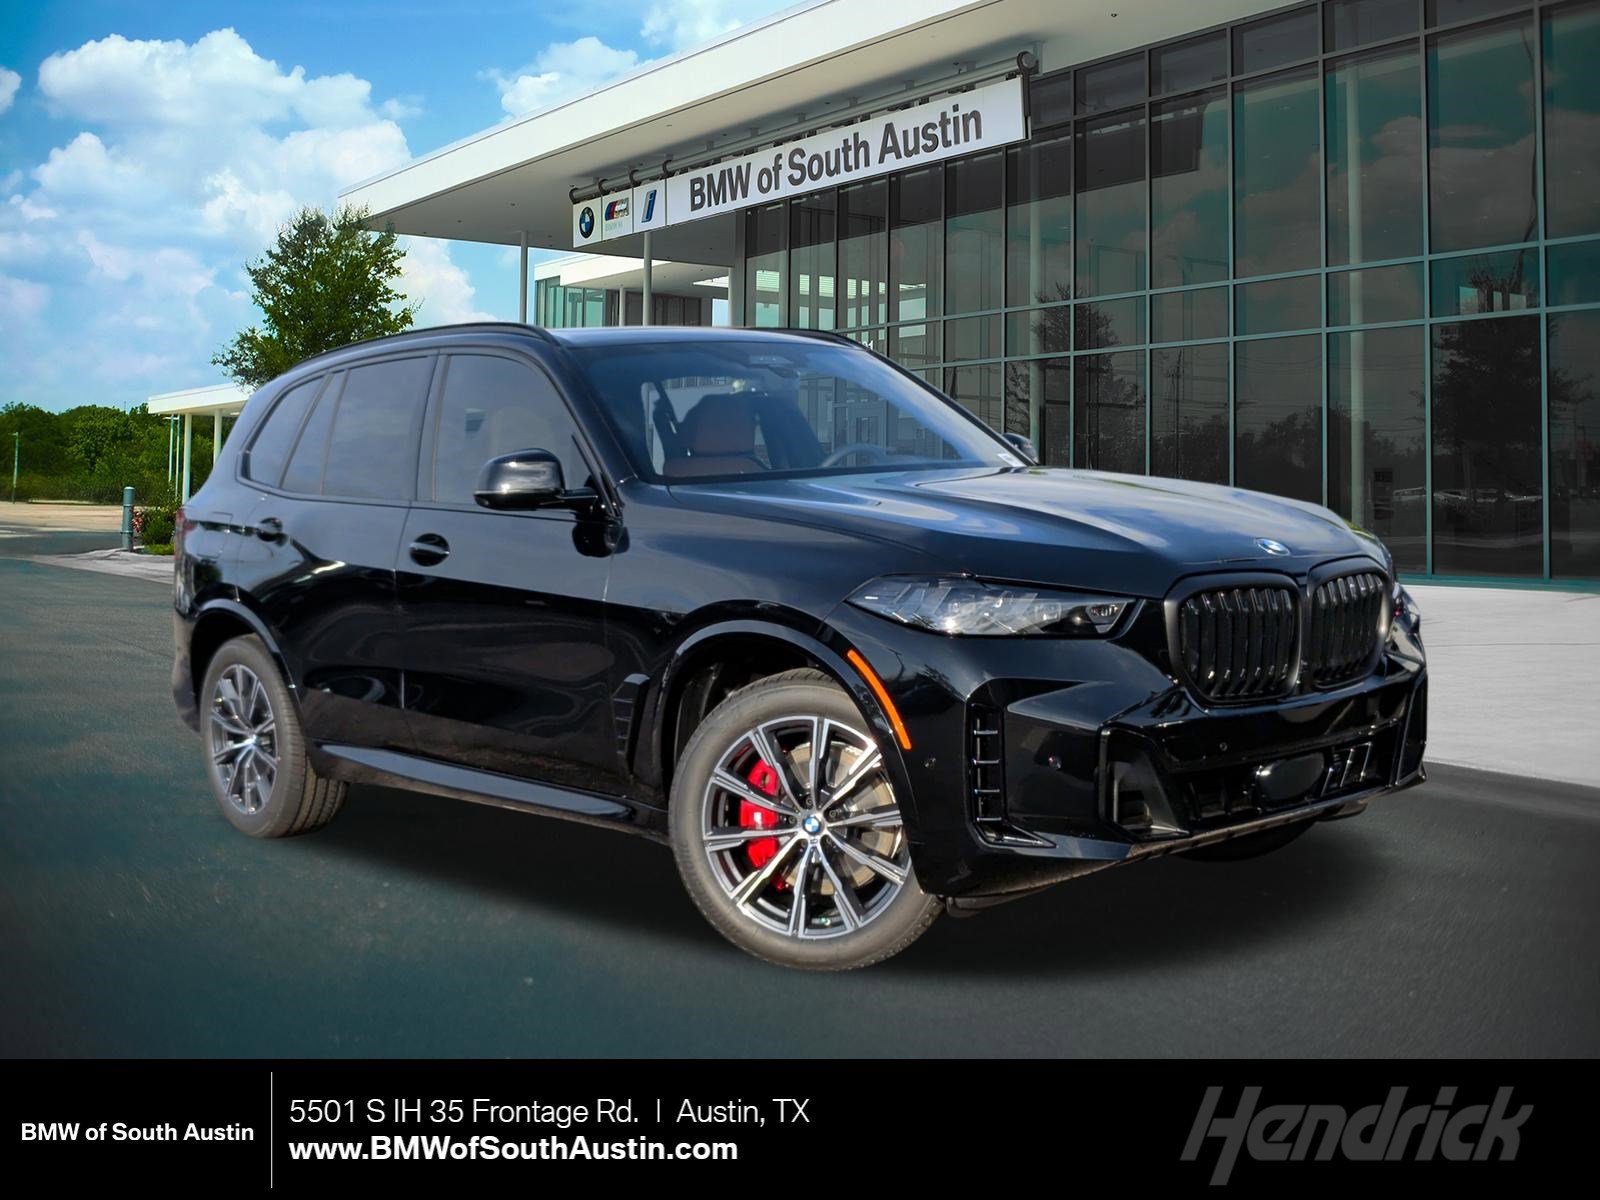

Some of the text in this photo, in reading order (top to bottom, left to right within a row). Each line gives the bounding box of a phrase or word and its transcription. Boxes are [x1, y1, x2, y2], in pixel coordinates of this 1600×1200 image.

[689, 103, 983, 212] BMW of South Austin
